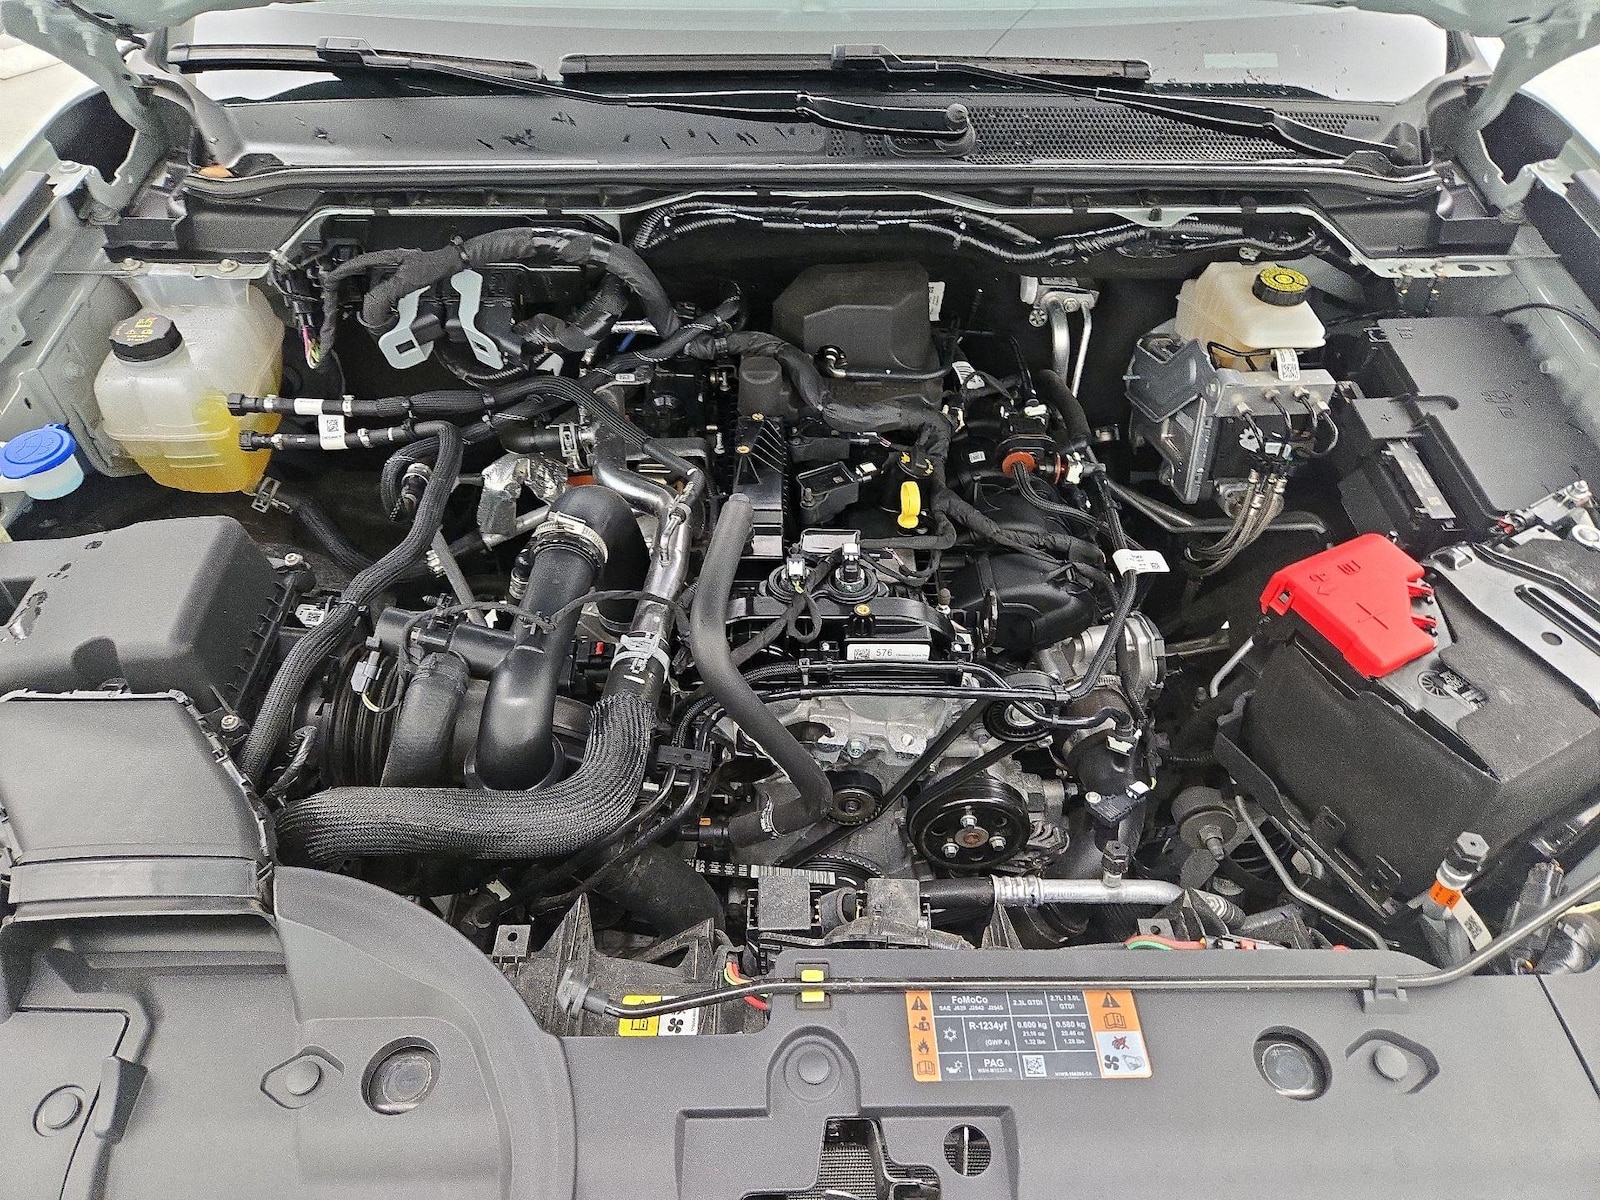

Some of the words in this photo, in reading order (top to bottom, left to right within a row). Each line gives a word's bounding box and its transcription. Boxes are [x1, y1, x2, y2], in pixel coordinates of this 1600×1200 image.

[876, 648, 893, 657] 576
[951, 995, 989, 1004] FoMoCo
[968, 1021, 1008, 1032] R-1234yf
[1016, 1021, 1037, 1029] 0.600
[1037, 1021, 1048, 1030] kg
[1076, 1020, 1087, 1029] kg
[985, 1039, 1003, 1047] (GWP
[983, 1058, 1005, 1068] PAG
